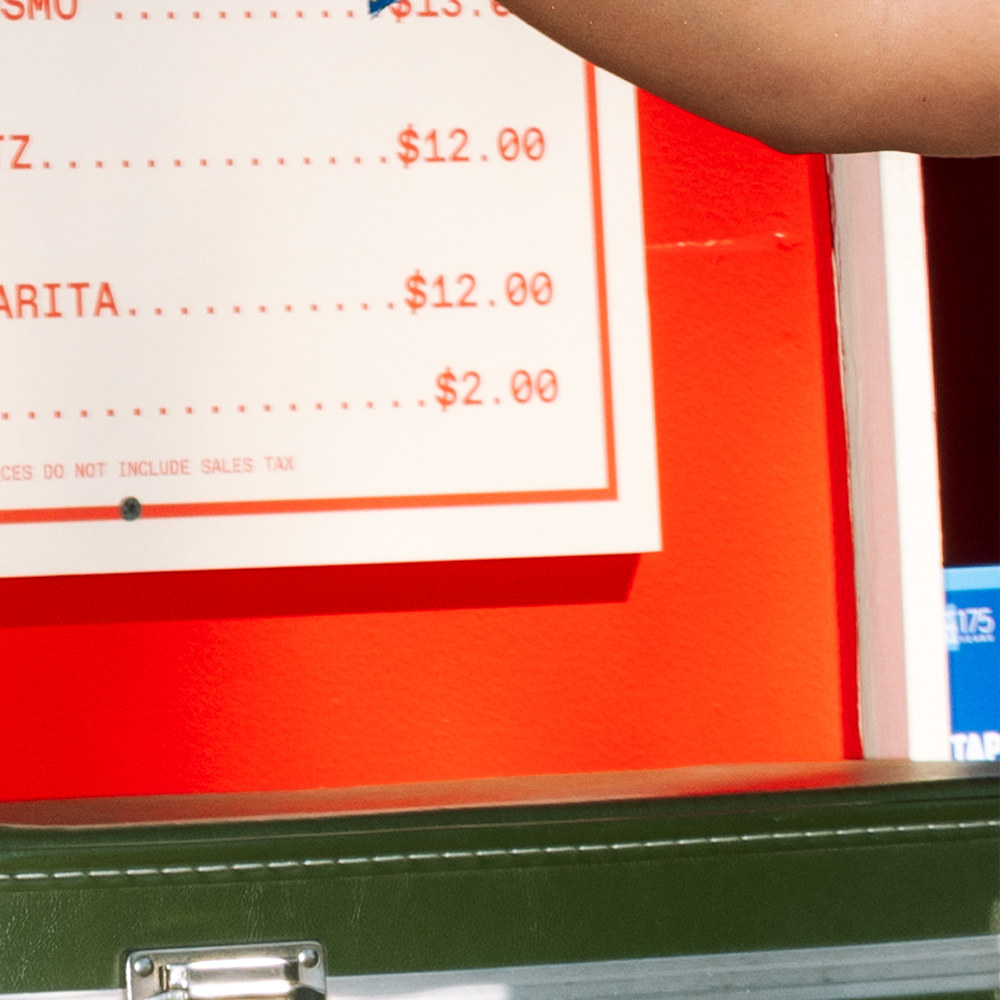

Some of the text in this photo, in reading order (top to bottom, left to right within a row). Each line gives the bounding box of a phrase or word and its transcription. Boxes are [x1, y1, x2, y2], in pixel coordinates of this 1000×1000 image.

[397, 124, 546, 167] $12.00
[404, 270, 554, 313] $12.00
[435, 367, 559, 411] $2.00
[42, 463, 66, 480] DO
[73, 461, 106, 478] NOT
[118, 458, 190, 477] INCLUDE
[200, 457, 254, 474] SALES
[264, 455, 295, 471] TAX
